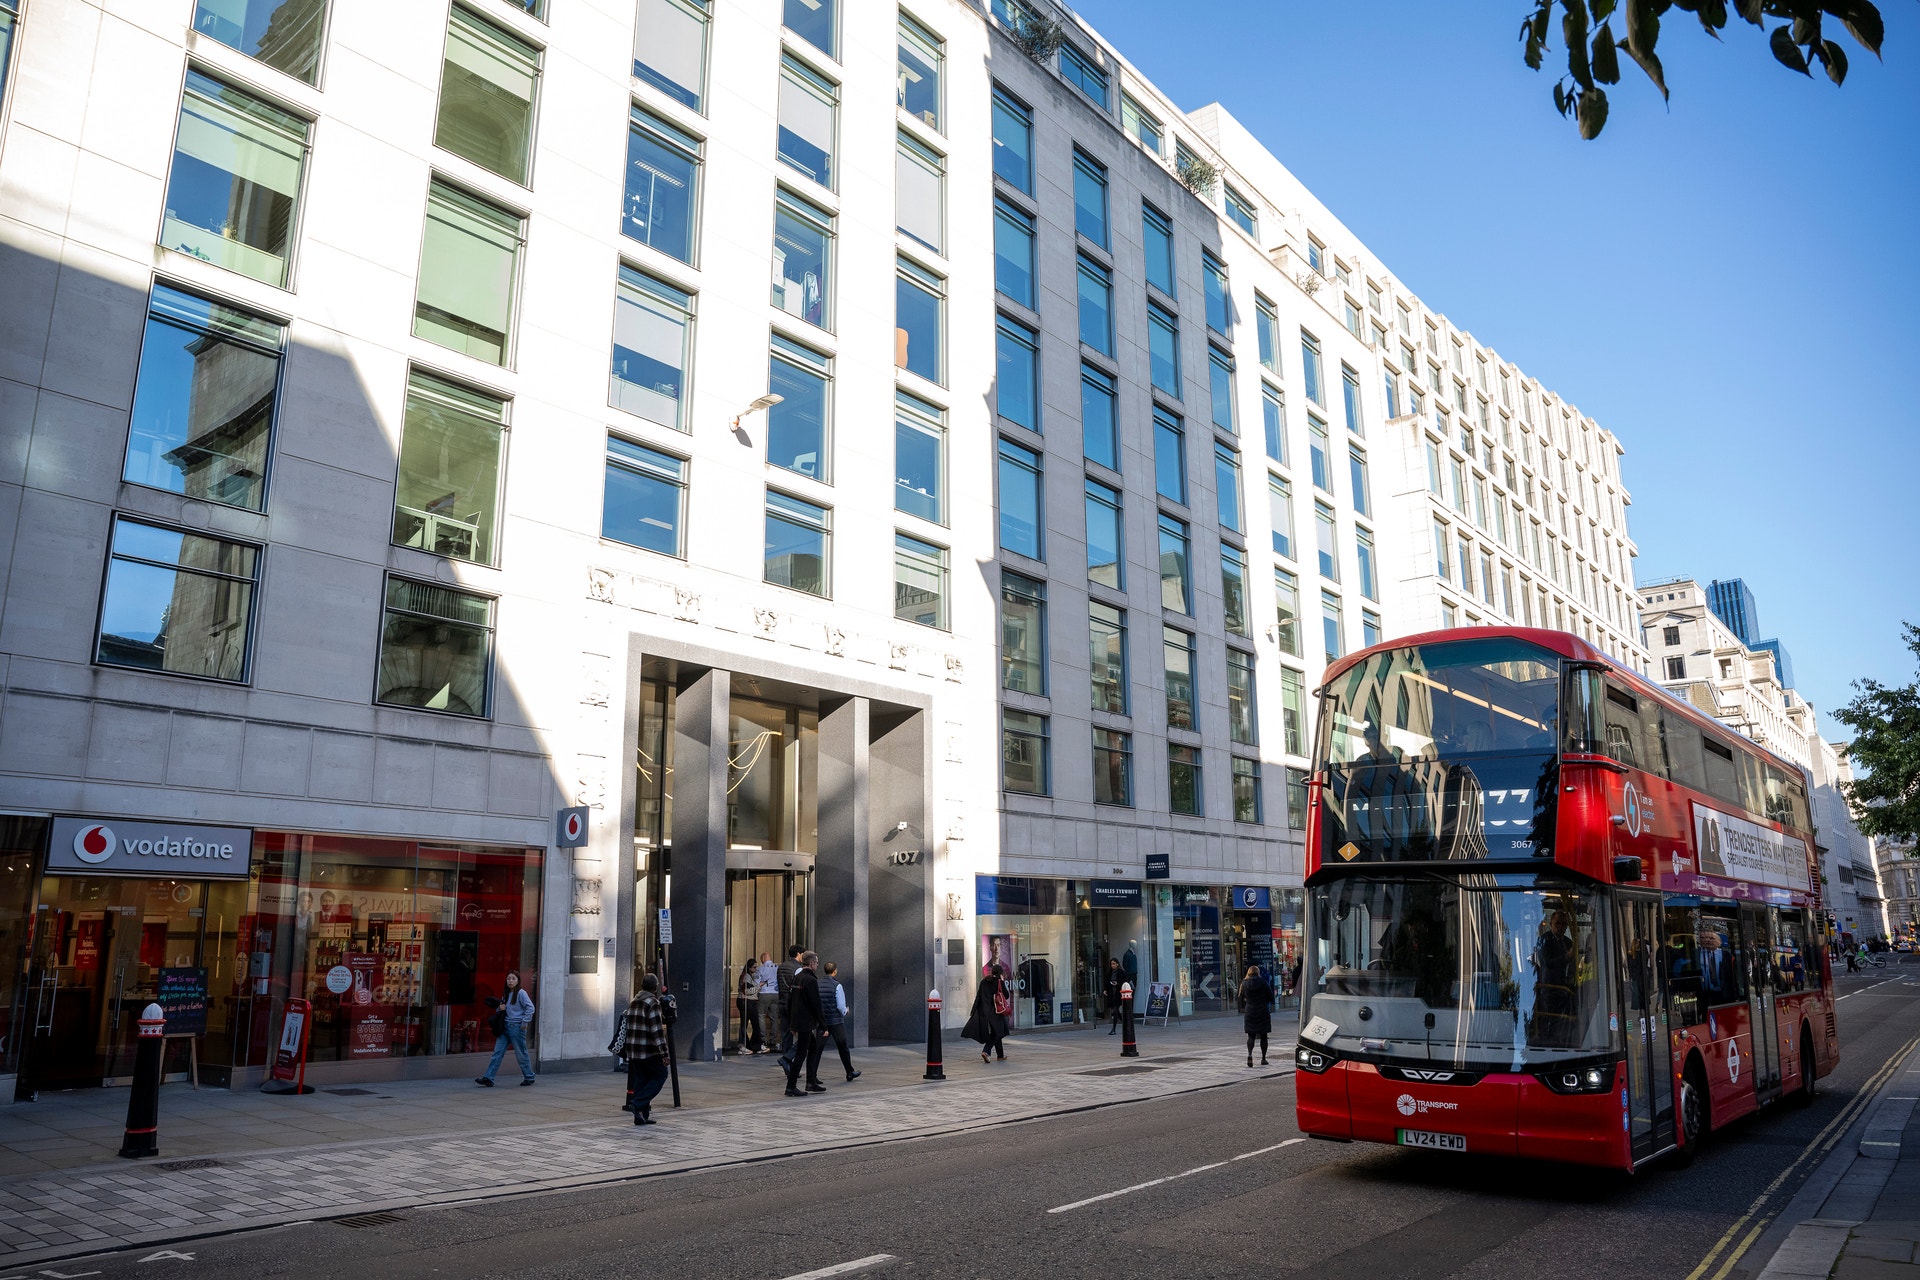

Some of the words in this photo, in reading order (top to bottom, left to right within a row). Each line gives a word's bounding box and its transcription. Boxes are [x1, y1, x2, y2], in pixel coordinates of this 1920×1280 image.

[1642, 796, 1648, 805] am
[1648, 798, 1653, 806] an
[1641, 809, 1655, 820] electric
[1643, 822, 1651, 833] bus
[122, 836, 234, 859] vodafone
[1511, 840, 1533, 849] 3067
[1724, 827, 1772, 859] TRENDSETTERS
[1771, 842, 1795, 864] WANTED
[891, 850, 919, 865] 107
[1186, 890, 1210, 902] pharmacy
[1004, 979, 1026, 990] RINO
[356, 1023, 387, 1034] EVERY
[358, 1034, 384, 1043] YEAR
[1416, 1099, 1458, 1110] TRANSPORT
[1405, 1131, 1436, 1146] LV24
[1440, 1135, 1464, 1149] EWD
